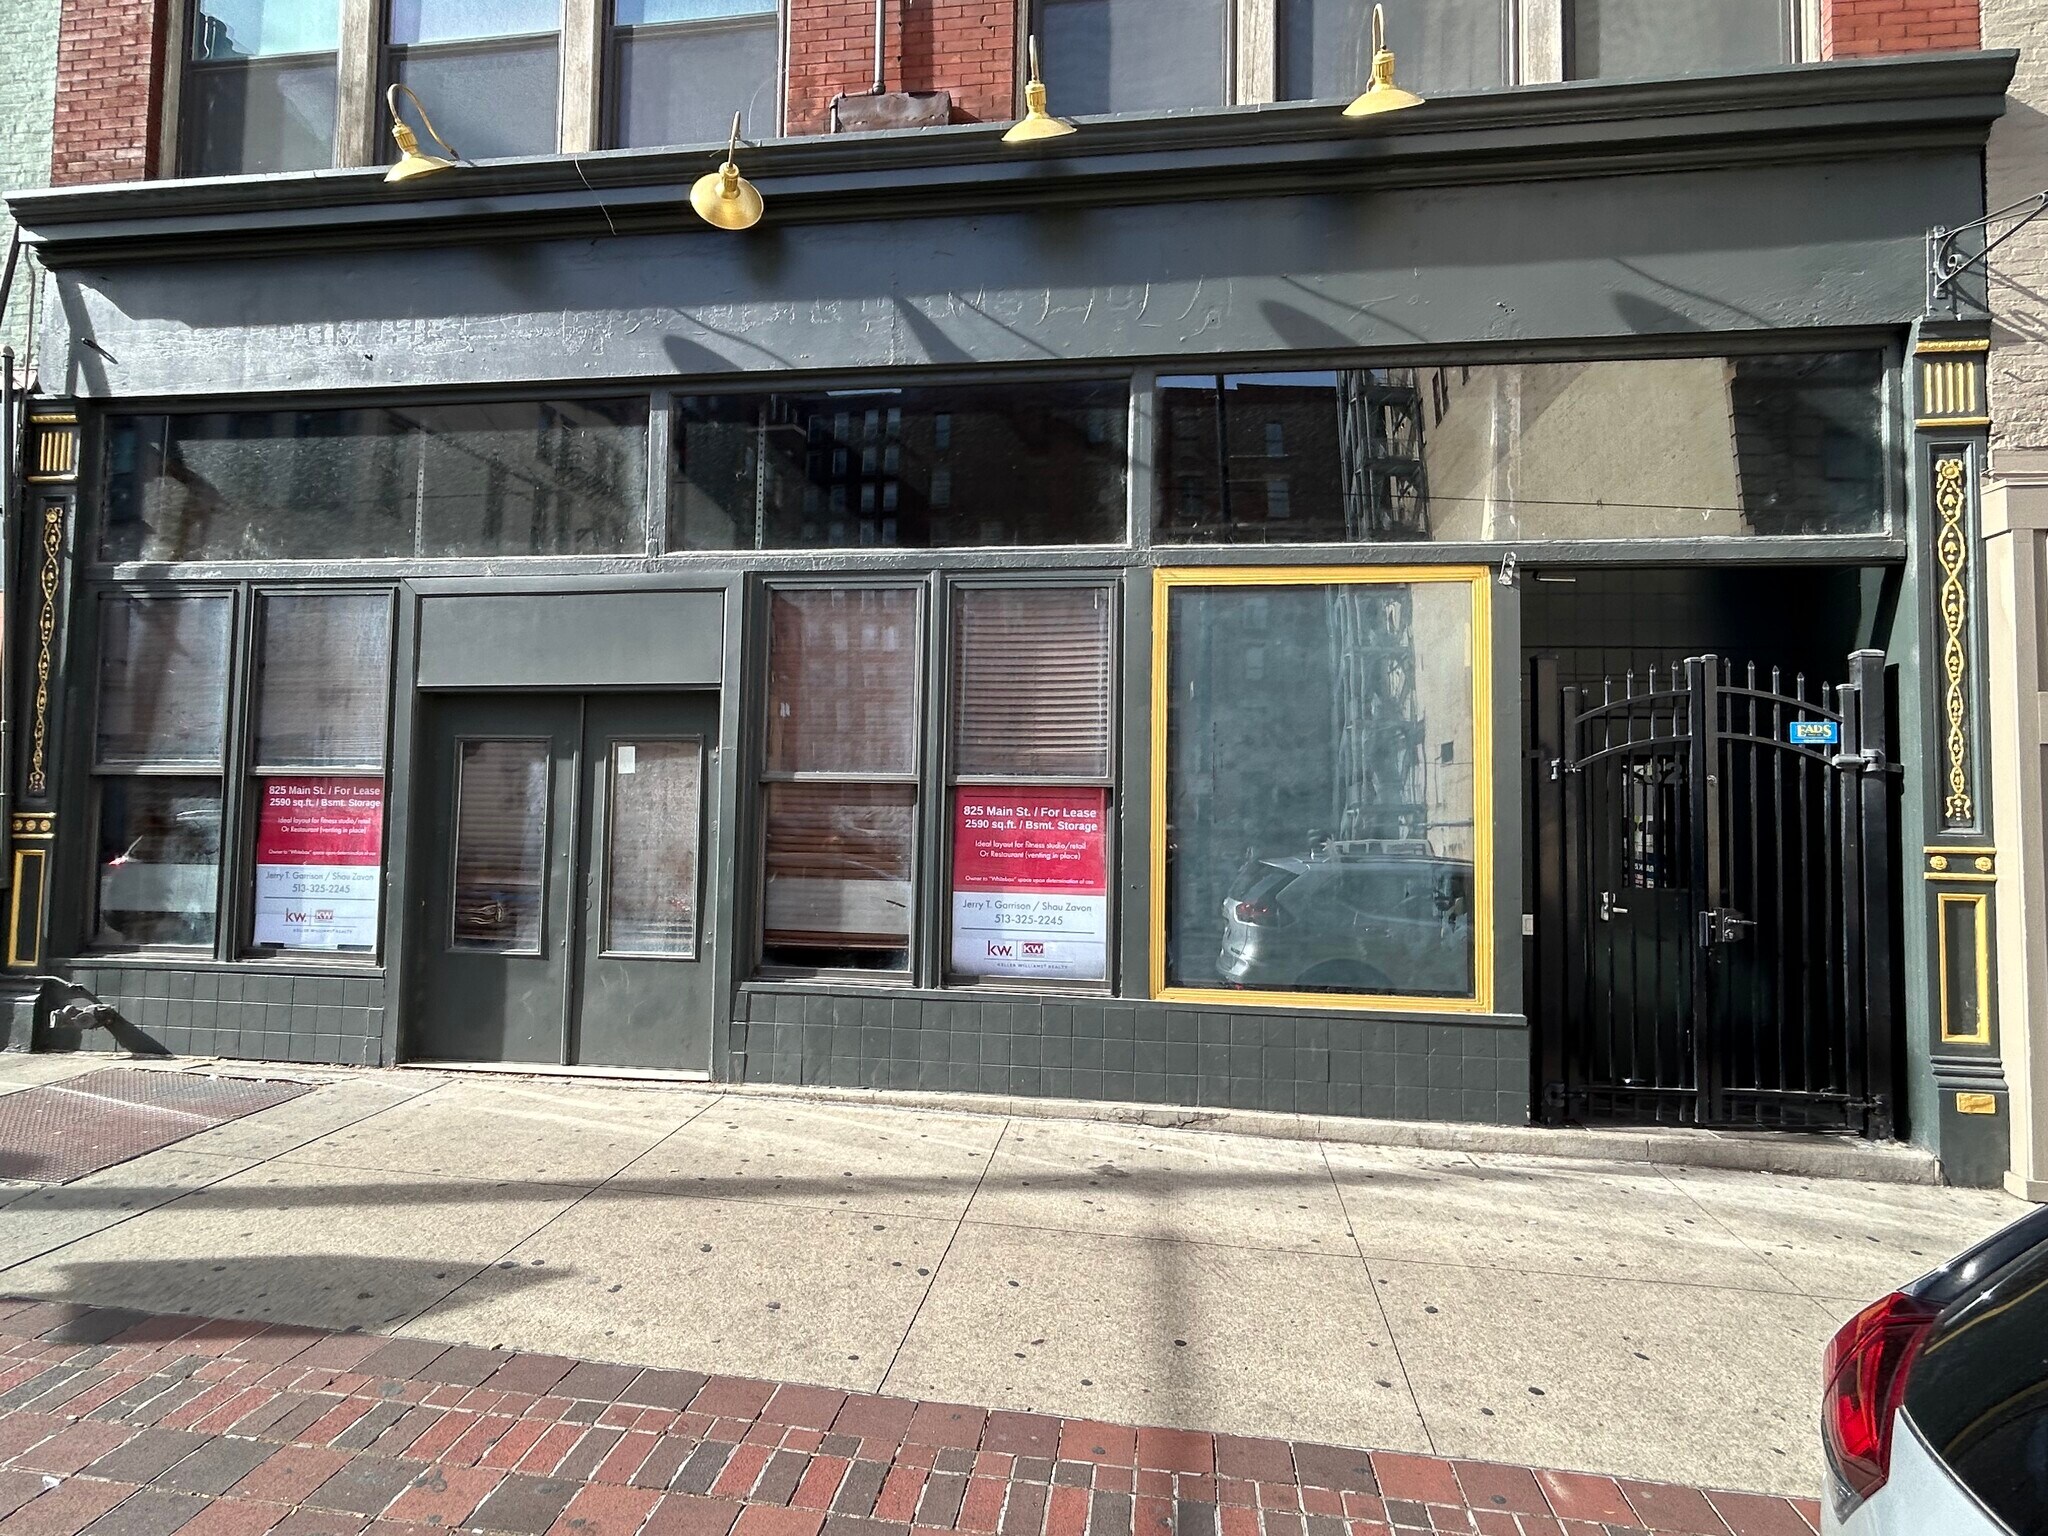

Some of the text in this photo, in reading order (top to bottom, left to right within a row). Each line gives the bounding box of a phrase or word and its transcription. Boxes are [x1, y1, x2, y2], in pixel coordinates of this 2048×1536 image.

[1797, 724, 1832, 737] EADS
[268, 785, 287, 795] 825
[288, 786, 311, 795] Main
[312, 787, 326, 795] St.
[334, 787, 351, 795] For
[353, 787, 381, 796] Lease
[269, 798, 291, 807] 2590
[292, 798, 315, 808] sq.ft.
[321, 799, 347, 807] Bsmt.
[348, 799, 381, 809] Storage
[963, 806, 984, 816] 825
[986, 806, 1013, 817] Main
[1016, 807, 1031, 817] St.
[1040, 807, 1060, 817] For
[1062, 808, 1097, 818] Lease
[293, 817, 311, 825] layout
[965, 819, 989, 829] 2590
[991, 819, 1017, 830] sq.ft.
[1025, 820, 1055, 830] Bsmt.
[1057, 821, 1098, 833] Storage
[281, 825, 290, 833] Or
[993, 840, 1014, 849] layout
[1014, 840, 1023, 848] for
[1025, 841, 1045, 849] fitness
[979, 850, 989, 858] Or
[1025, 851, 1051, 861] (venting
[1059, 852, 1081, 861] place)
[265, 871, 285, 881] Jerry
[292, 872, 324, 880] Garrison
[332, 872, 350, 881] Shau
[292, 883, 351, 894] 513-325-2245
[962, 900, 984, 910] Jerry
[986, 900, 992, 908] T.
[994, 900, 1031, 910] Garrison
[1042, 902, 1063, 911] Shau
[1065, 903, 1092, 912] Zavon
[994, 914, 1063, 925] 513-325-2245
[1023, 944, 1043, 954] KW
